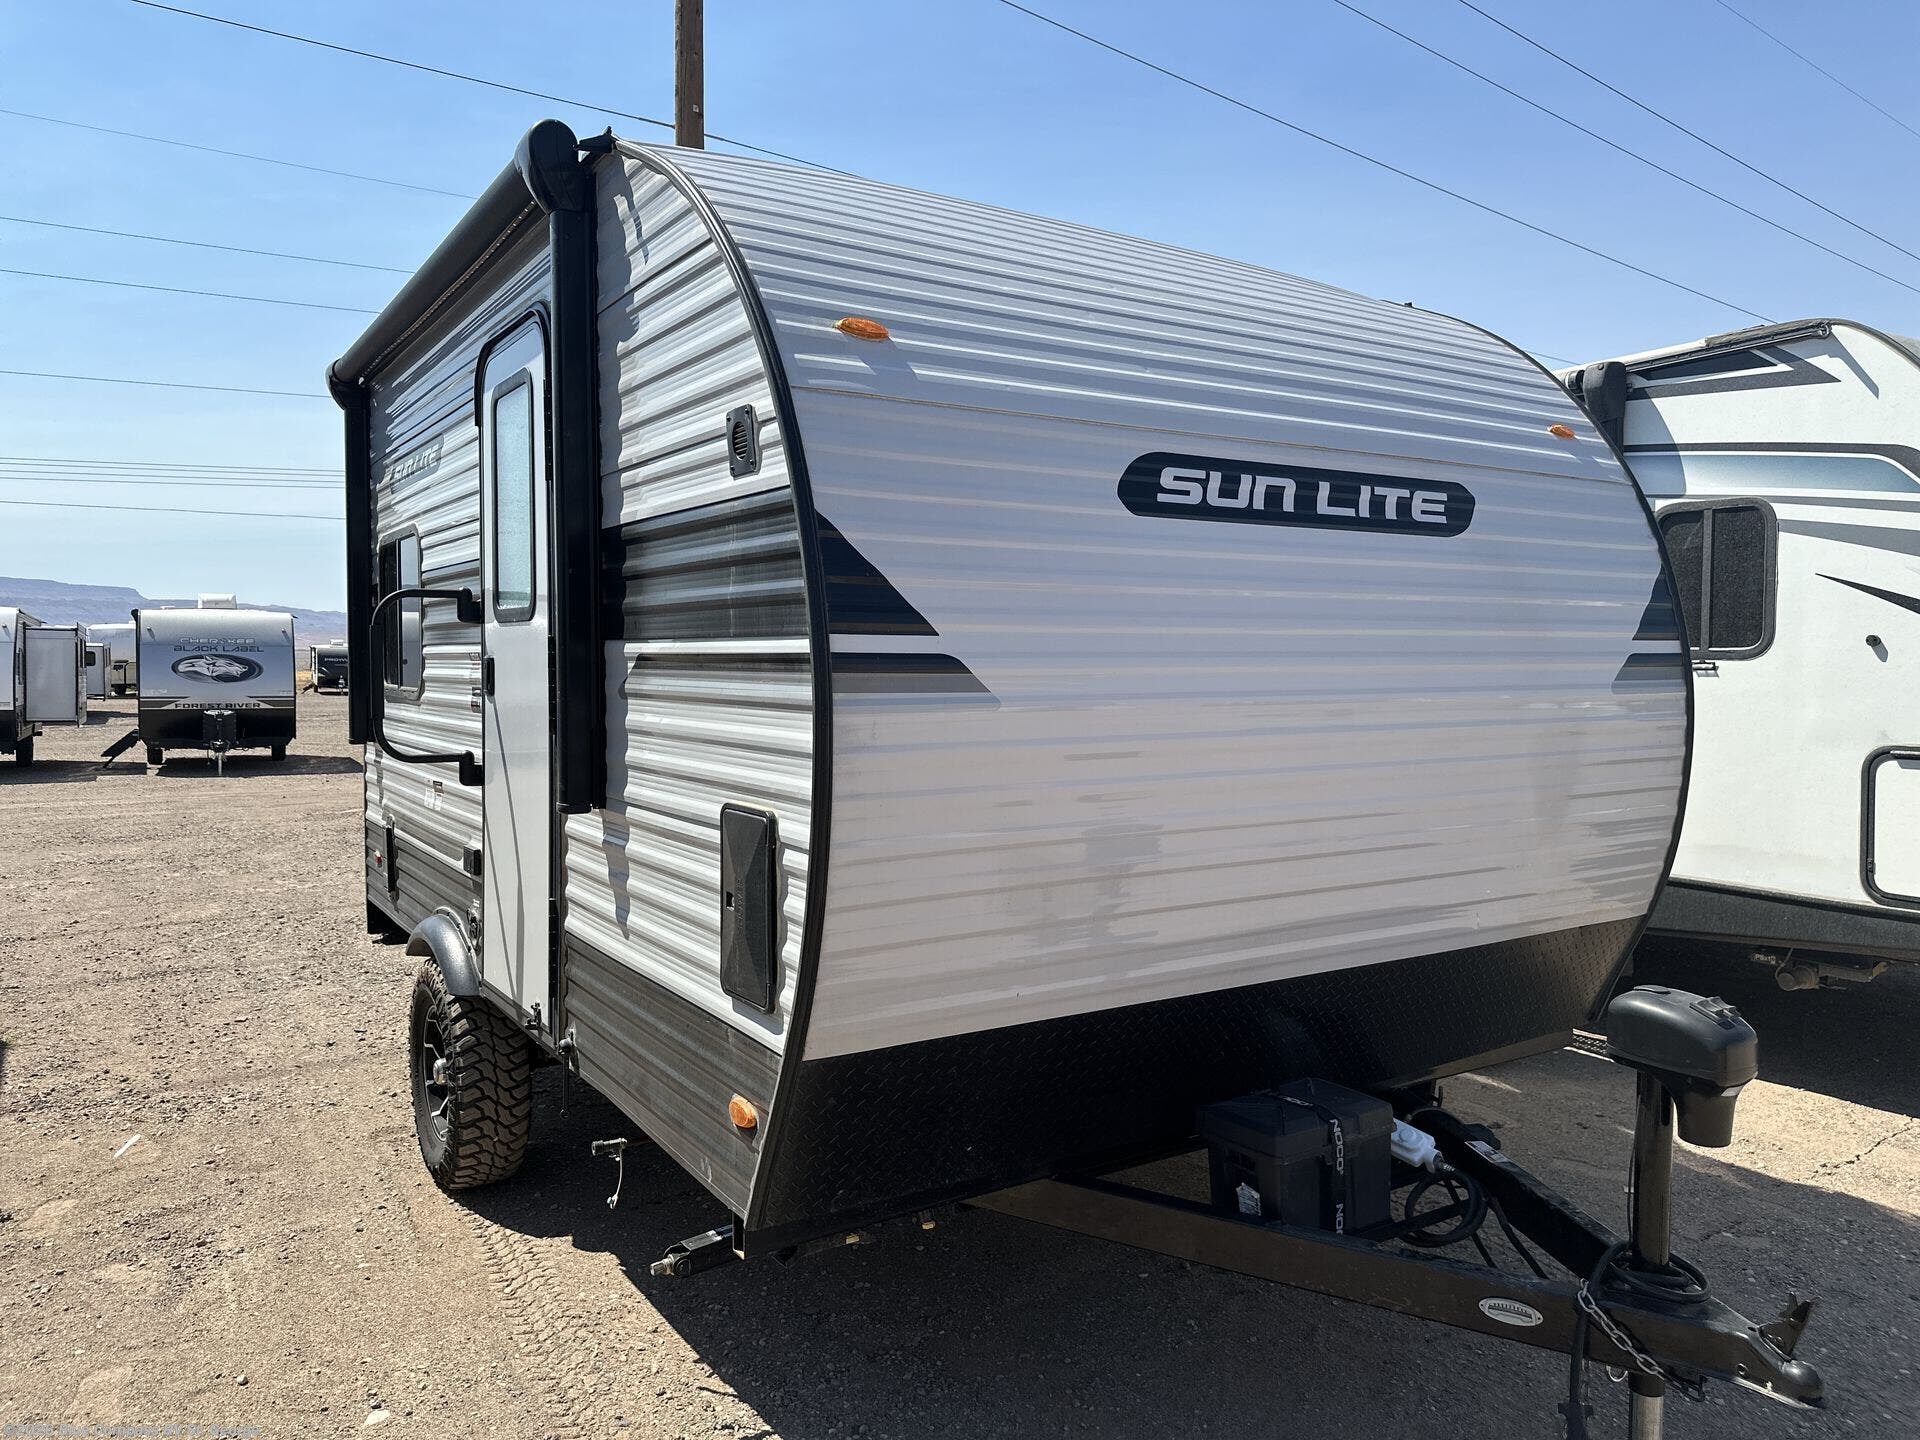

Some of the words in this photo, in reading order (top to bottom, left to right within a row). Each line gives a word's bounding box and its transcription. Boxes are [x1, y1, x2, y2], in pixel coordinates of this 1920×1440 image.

[1156, 466, 1297, 513] SUN
[1316, 481, 1448, 524] LITE
[222, 645, 264, 653] LABEL
[1329, 1118, 1345, 1174] NOCO
